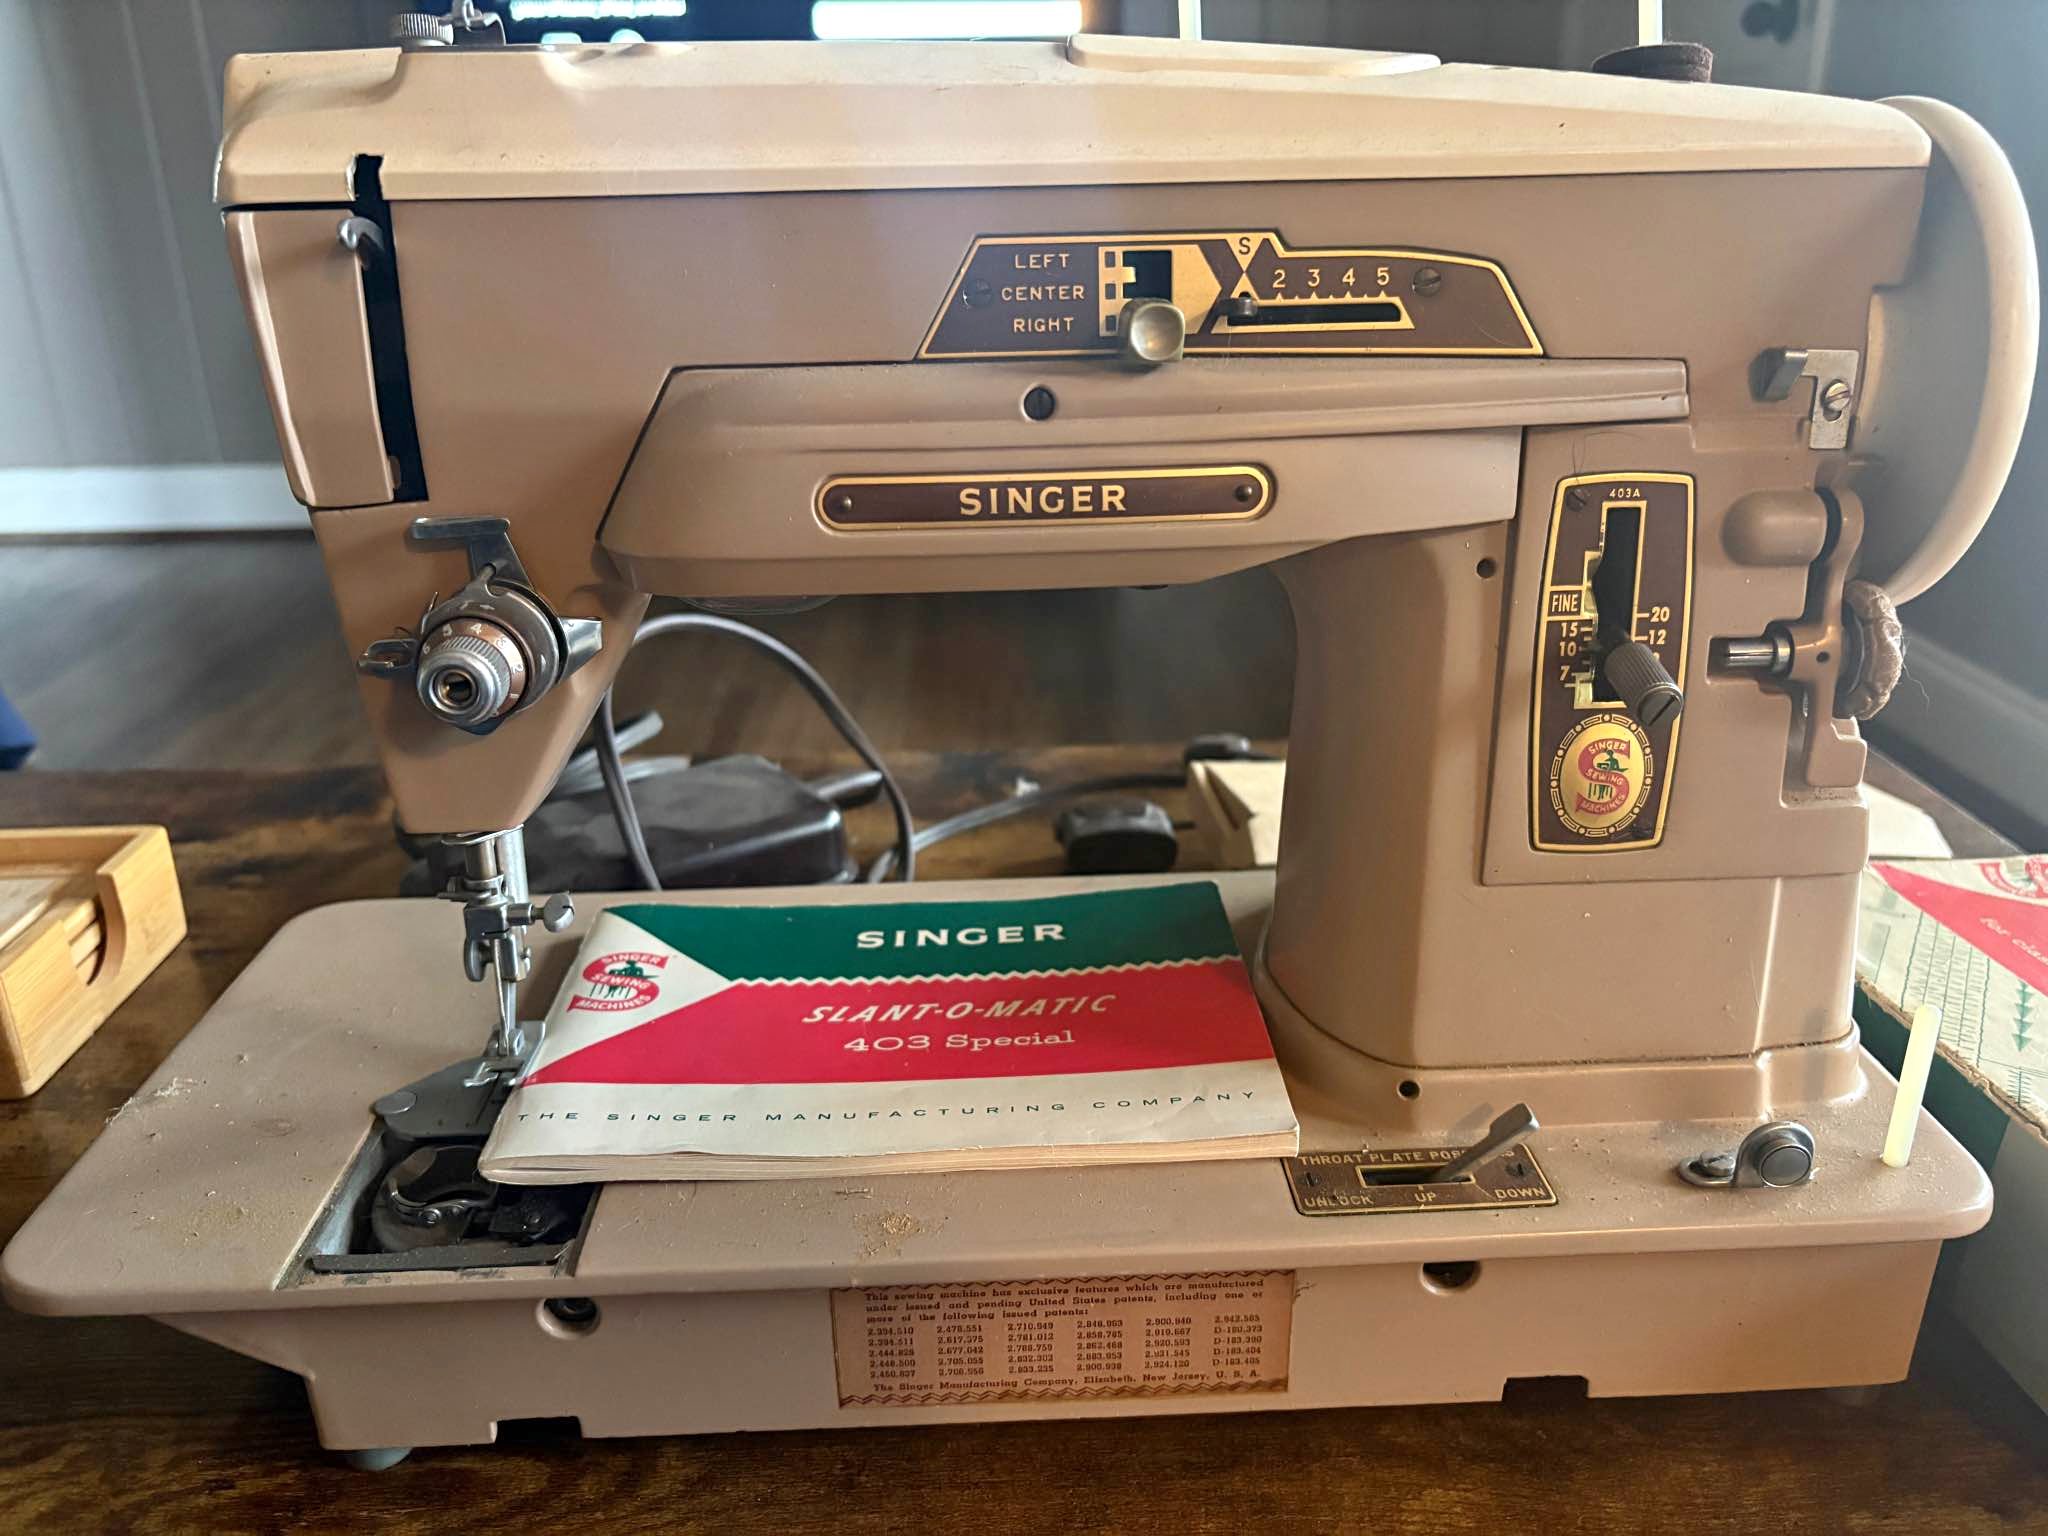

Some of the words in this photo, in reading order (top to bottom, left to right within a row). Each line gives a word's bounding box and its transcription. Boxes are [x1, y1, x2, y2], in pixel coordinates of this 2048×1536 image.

[1238, 237, 1251, 256] S
[1014, 252, 1070, 270] LEFT
[1273, 269, 1286, 288] 2
[1307, 269, 1321, 288] 3
[1342, 268, 1356, 287] 4
[1376, 267, 1390, 286] 5
[1001, 283, 1085, 301] CENTER
[1013, 315, 1075, 333] RIGHT
[959, 484, 1127, 516] SINGER
[1609, 488, 1640, 498] 403A
[1551, 594, 1578, 613] FINE
[1650, 607, 1670, 622] 20
[470, 623, 482, 635] 4
[1561, 623, 1578, 637] 15
[1649, 630, 1666, 645] 12
[1559, 642, 1577, 656] 10
[1560, 666, 1570, 681] 7
[1588, 741, 1626, 754] SINGER
[1586, 768, 1624, 786] SEWING
[857, 924, 1067, 949] SINGER
[602, 953, 661, 964] SINGER
[592, 973, 651, 989] SEWING
[575, 995, 651, 1010] MACHINES
[802, 994, 1118, 1024] SLANT-O-MATIC
[843, 1034, 931, 1052] 403
[945, 1030, 1074, 1051] Special
[518, 1112, 579, 1121] THE
[607, 1113, 736, 1122] SINGER
[765, 1103, 1066, 1121] MANUFACTURING
[1093, 1090, 1256, 1110] COMPANY
[1300, 1153, 1363, 1166] THROAT
[1371, 1152, 1424, 1163] PLATE
[1304, 1195, 1373, 1208] UNLOCK
[1415, 1193, 1436, 1203] UP
[1495, 1187, 1545, 1200] DOWN
[865, 1292, 888, 1301] This
[895, 1291, 934, 1301] sewing
[940, 1289, 986, 1299] machine
[993, 1288, 1011, 1297] has
[1018, 1286, 1069, 1296] exclusive
[1075, 1284, 1119, 1294] features
[1126, 1283, 1159, 1292] which
[1188, 1279, 1264, 1290] manufactured
[866, 1304, 897, 1312] under
[906, 1302, 940, 1311] issued
[948, 1301, 969, 1310] and
[977, 1300, 1022, 1310] pending
[1029, 1297, 1065, 1307] United
[1072, 1296, 1106, 1305] States
[1114, 1295, 1157, 1305] patents,
[1165, 1291, 1217, 1302] including
[866, 1316, 893, 1324] more
[901, 1314, 912, 1322] of
[919, 1313, 935, 1321] the
[943, 1311, 995, 1322] following
[1002, 1309, 1037, 1319] issued
[1045, 1308, 1088, 1319] patents:
[873, 1383, 893, 1392] The
[899, 1381, 934, 1392] Singer
[939, 1379, 1018, 1390] Manufacturing
[1143, 1373, 1166, 1382] New
